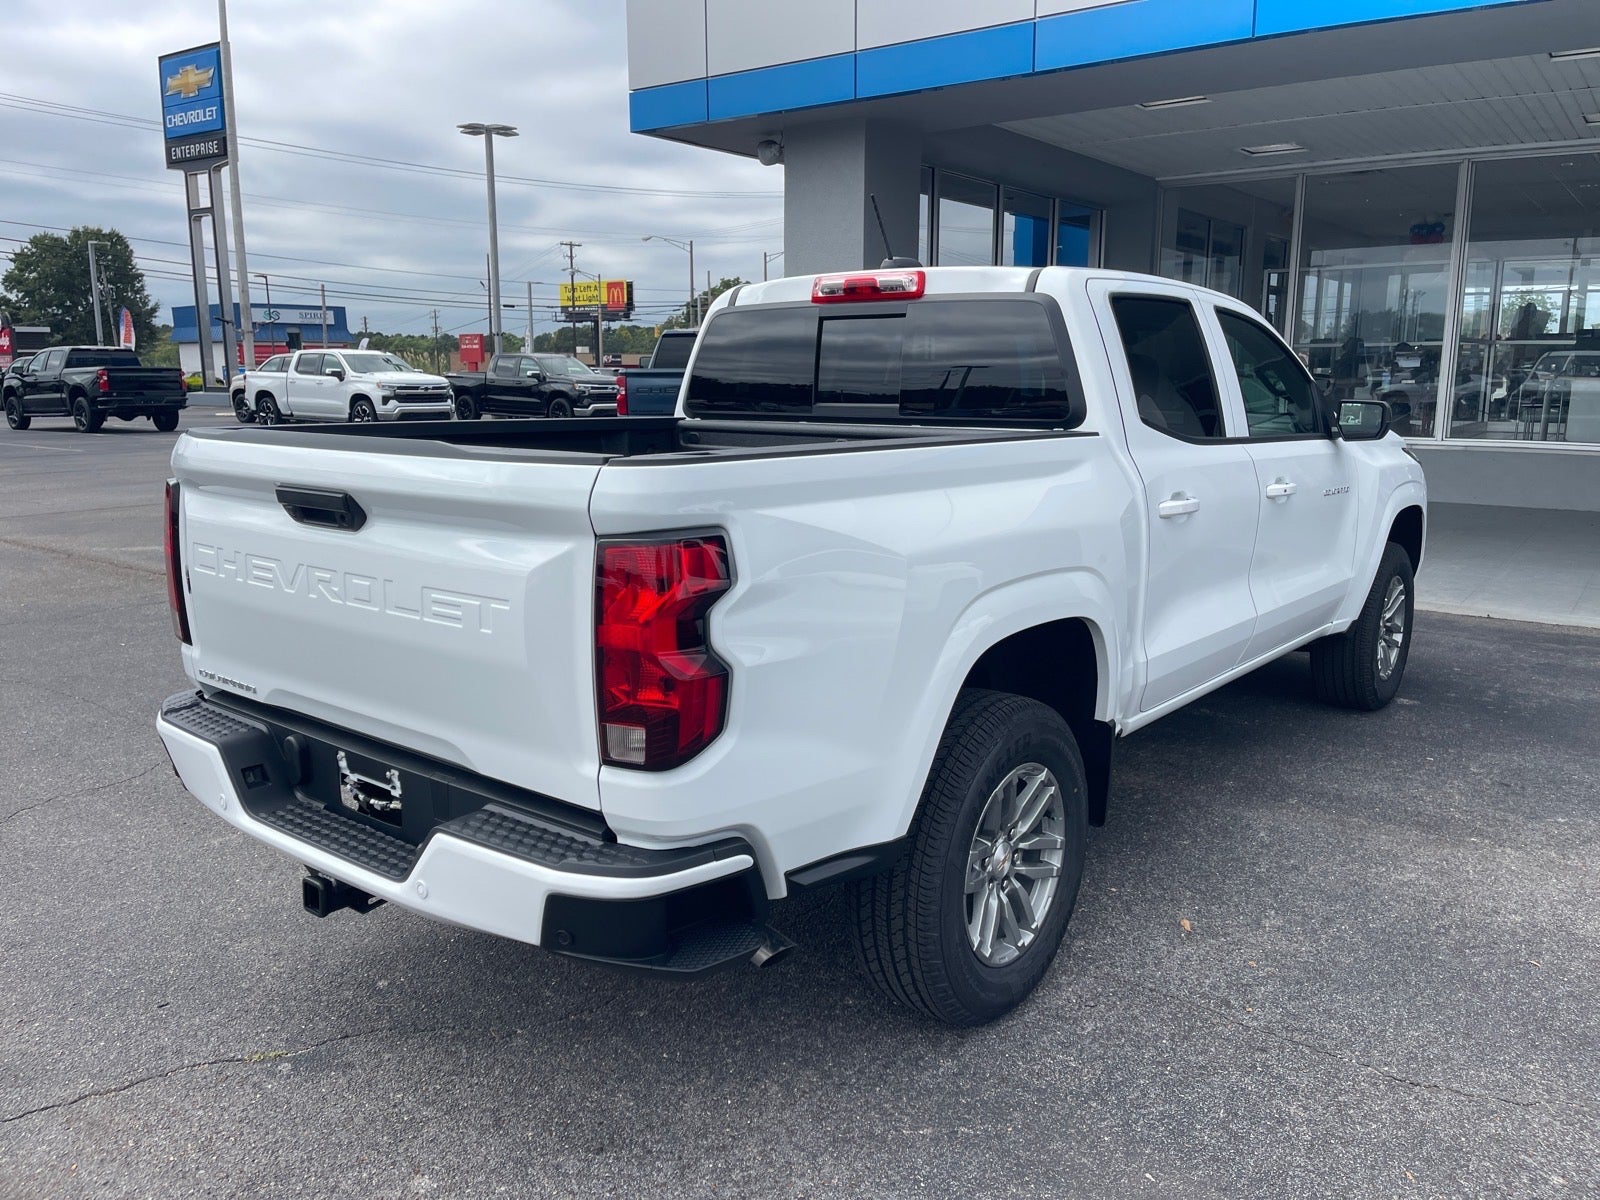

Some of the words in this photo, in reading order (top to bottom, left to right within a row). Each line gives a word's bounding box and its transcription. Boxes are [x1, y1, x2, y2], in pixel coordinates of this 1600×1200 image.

[166, 106, 218, 128] CHEVROLET
[171, 140, 219, 160] ENTERPRISE
[564, 286, 578, 294] Tun
[580, 284, 592, 293] Left
[298, 311, 328, 320] SPIRI
[192, 541, 510, 634] CHEVROLET
